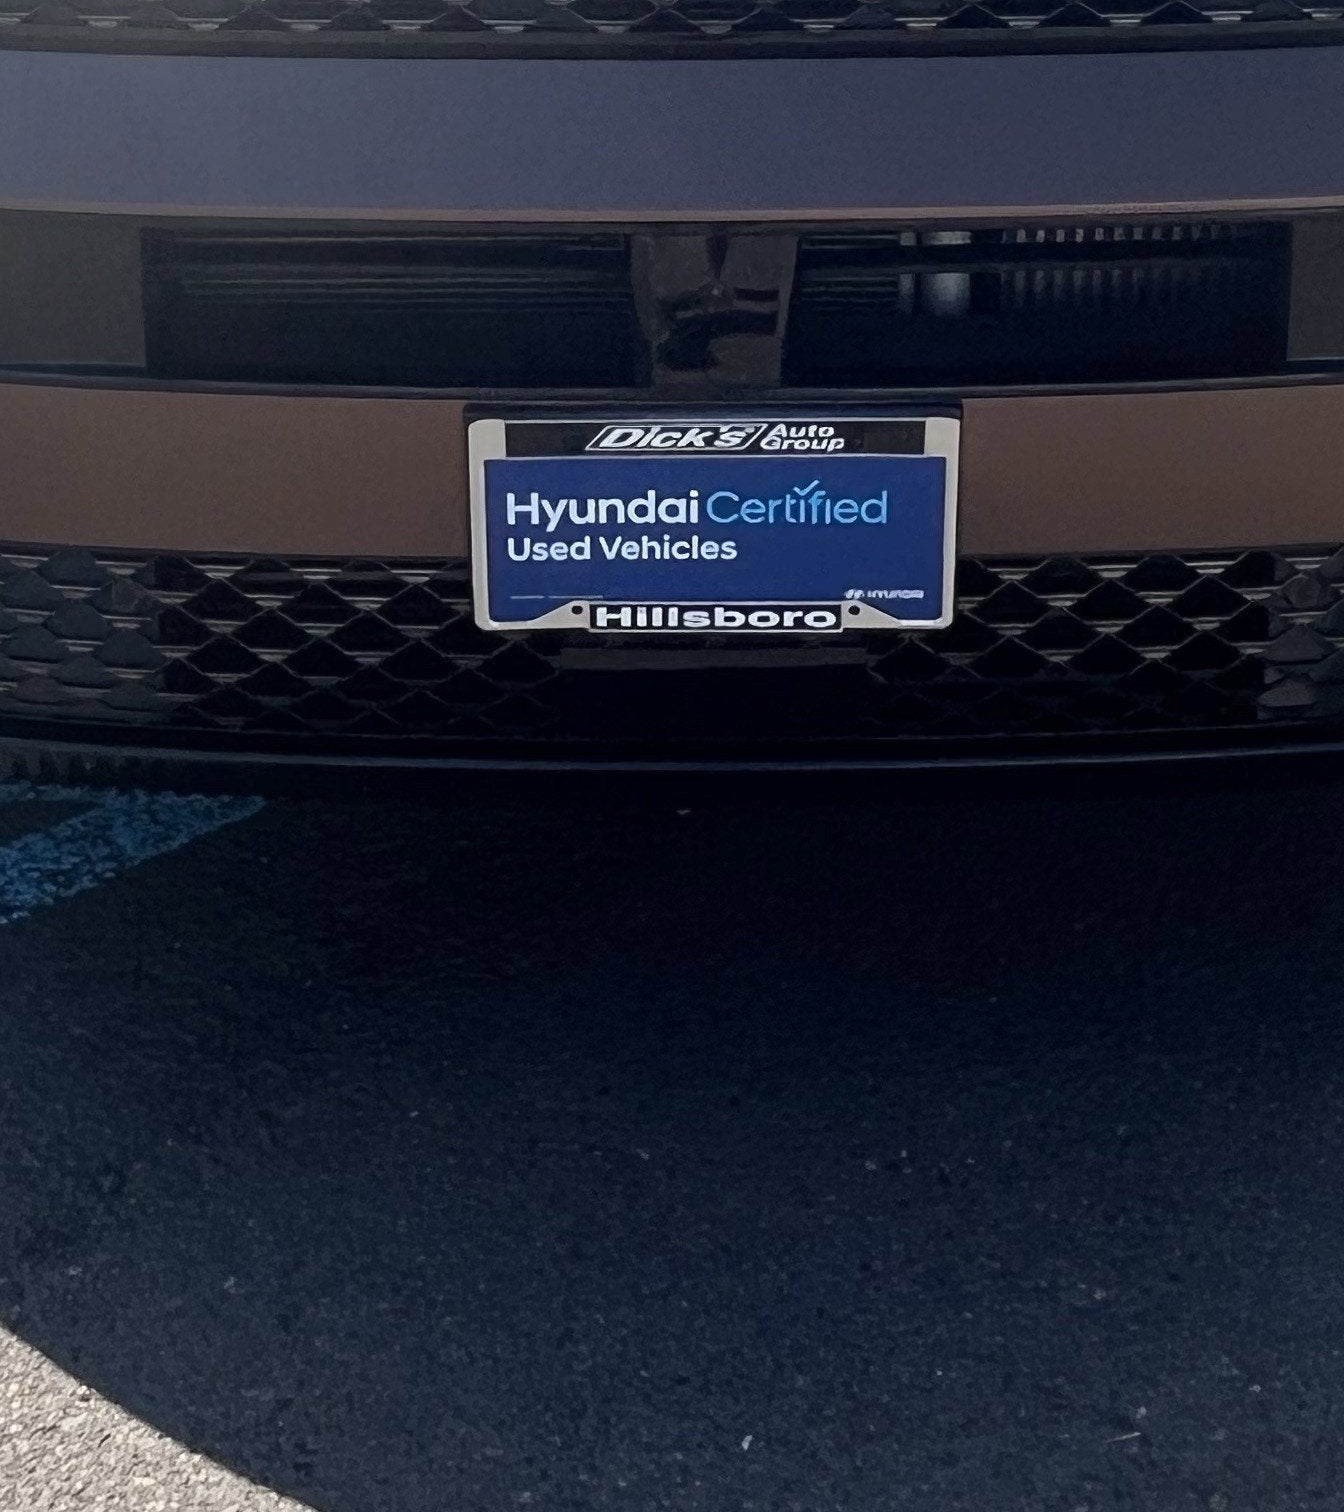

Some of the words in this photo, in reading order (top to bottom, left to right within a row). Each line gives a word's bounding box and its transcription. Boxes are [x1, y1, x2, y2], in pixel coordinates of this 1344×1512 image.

[766, 423, 836, 438] Auto
[759, 436, 846, 452] Group
[506, 489, 699, 532] Hyundai
[706, 480, 888, 525] Certified
[506, 535, 592, 562] Used
[598, 534, 739, 561] Vehicles
[595, 606, 838, 629] Hillsboro
